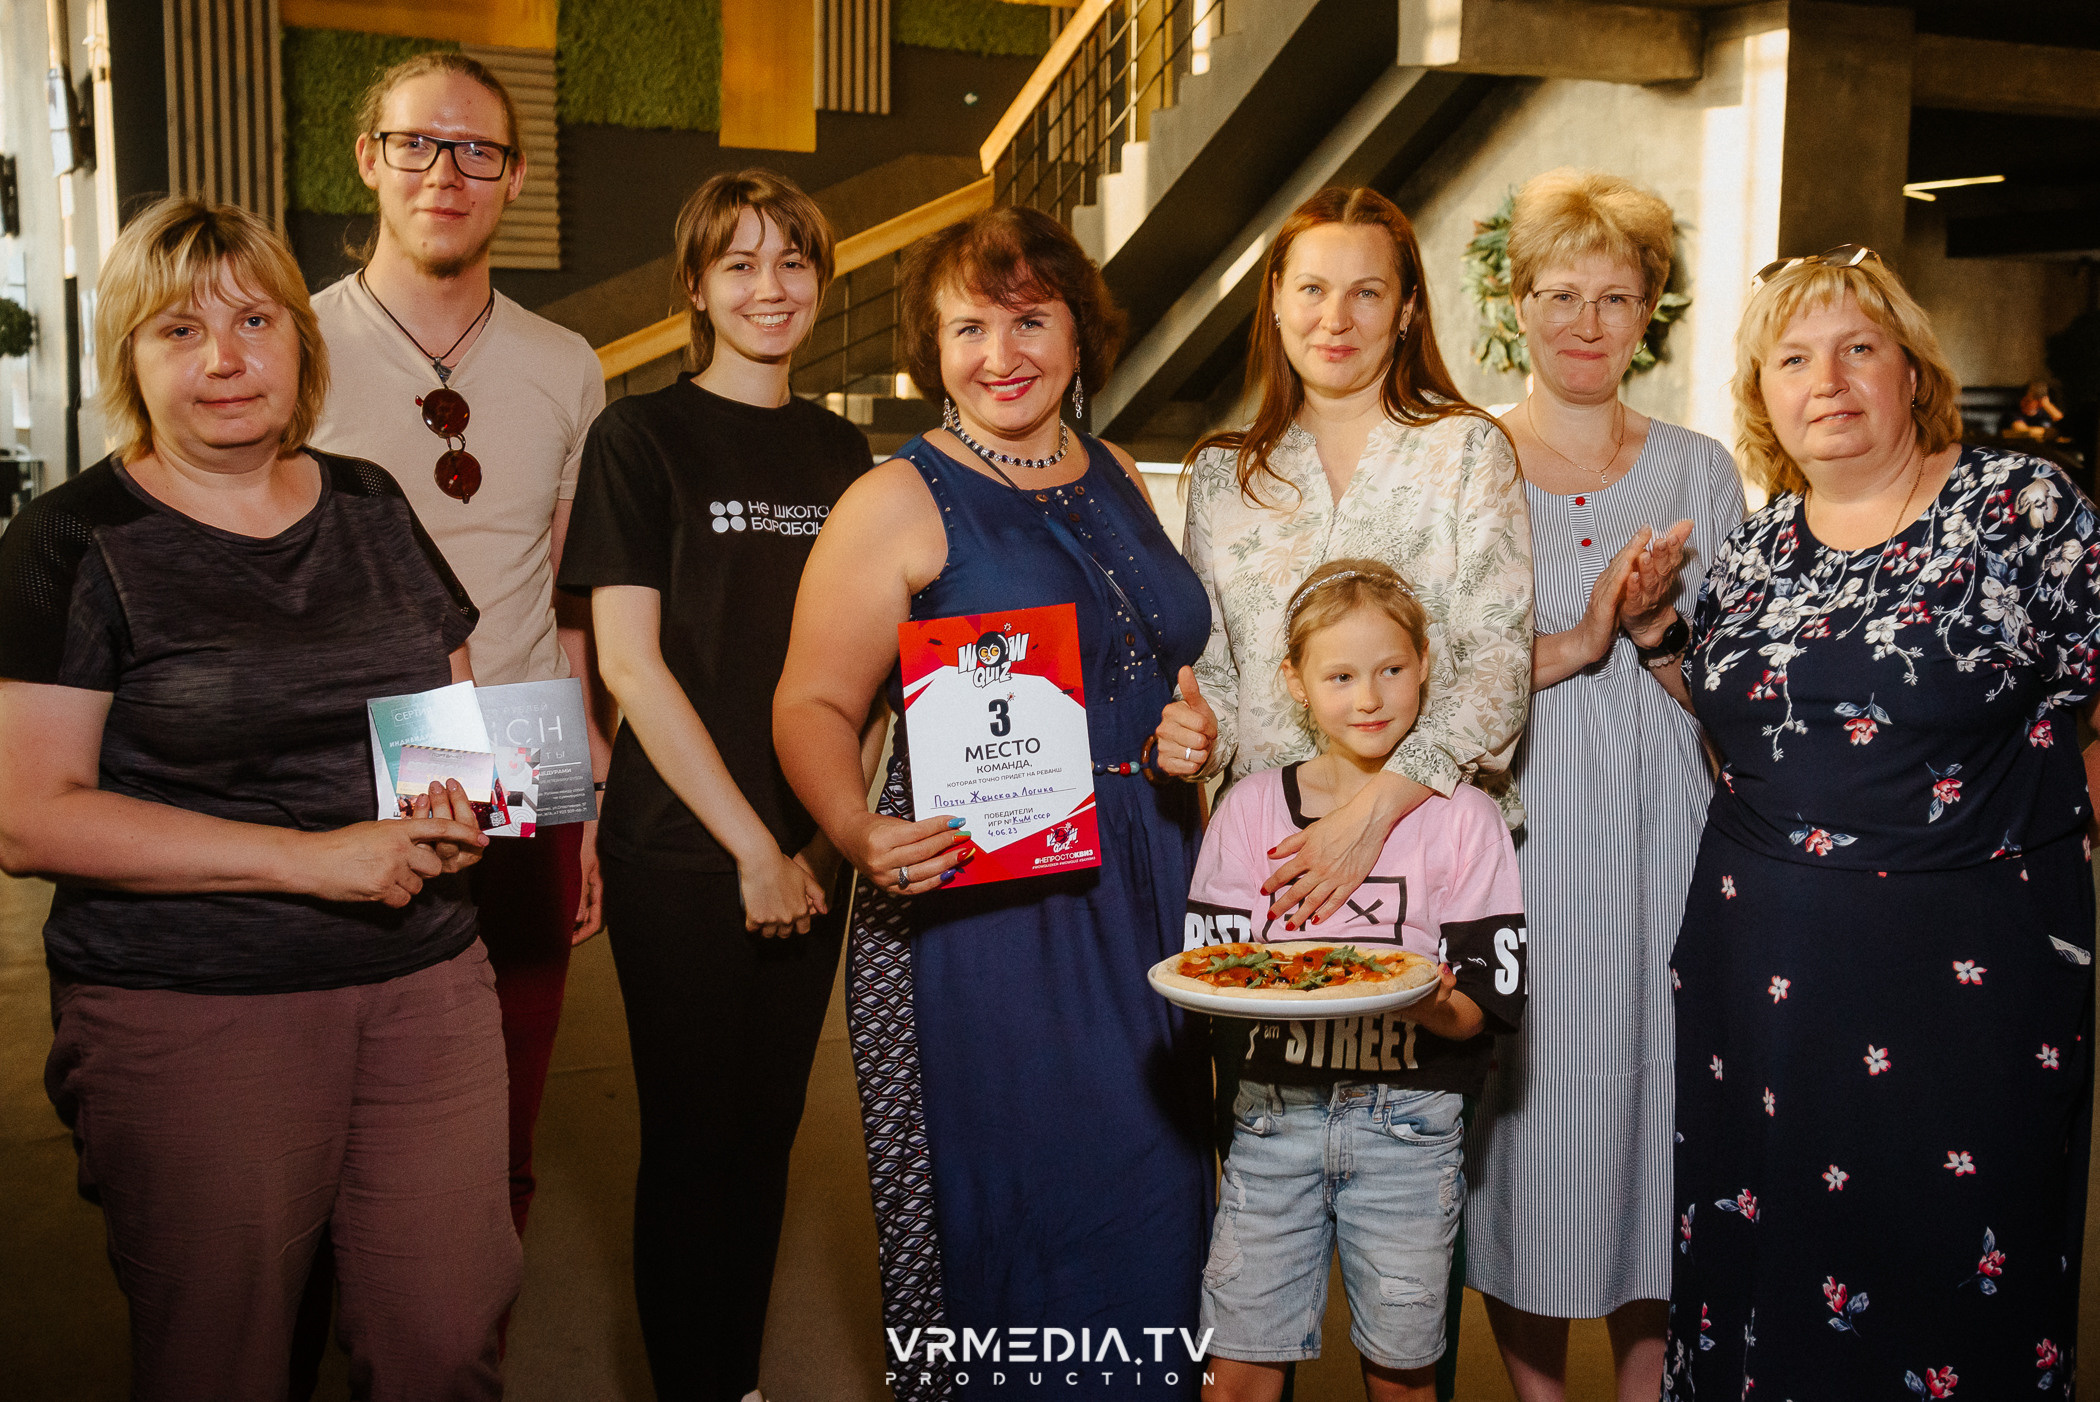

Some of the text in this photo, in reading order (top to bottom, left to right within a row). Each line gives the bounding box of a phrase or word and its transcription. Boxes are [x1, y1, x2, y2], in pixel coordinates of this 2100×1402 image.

[973, 660, 1012, 689] QUIZ
[988, 699, 1011, 737] 3
[965, 738, 1041, 763] МЕСТО
[976, 759, 1033, 774] КОМАНДА,
[947, 779, 977, 788] КОТОРАЯ
[978, 776, 1000, 784] ТОЧНО
[1001, 772, 1025, 781] ПРИДЕТ
[970, 790, 1019, 804] Женская
[1021, 786, 1054, 798] Логика
[984, 807, 1034, 820] ПОБЕДИТЕЛИ
[987, 827, 1018, 837] 4.06.23
[988, 820, 1003, 828] ИГР
